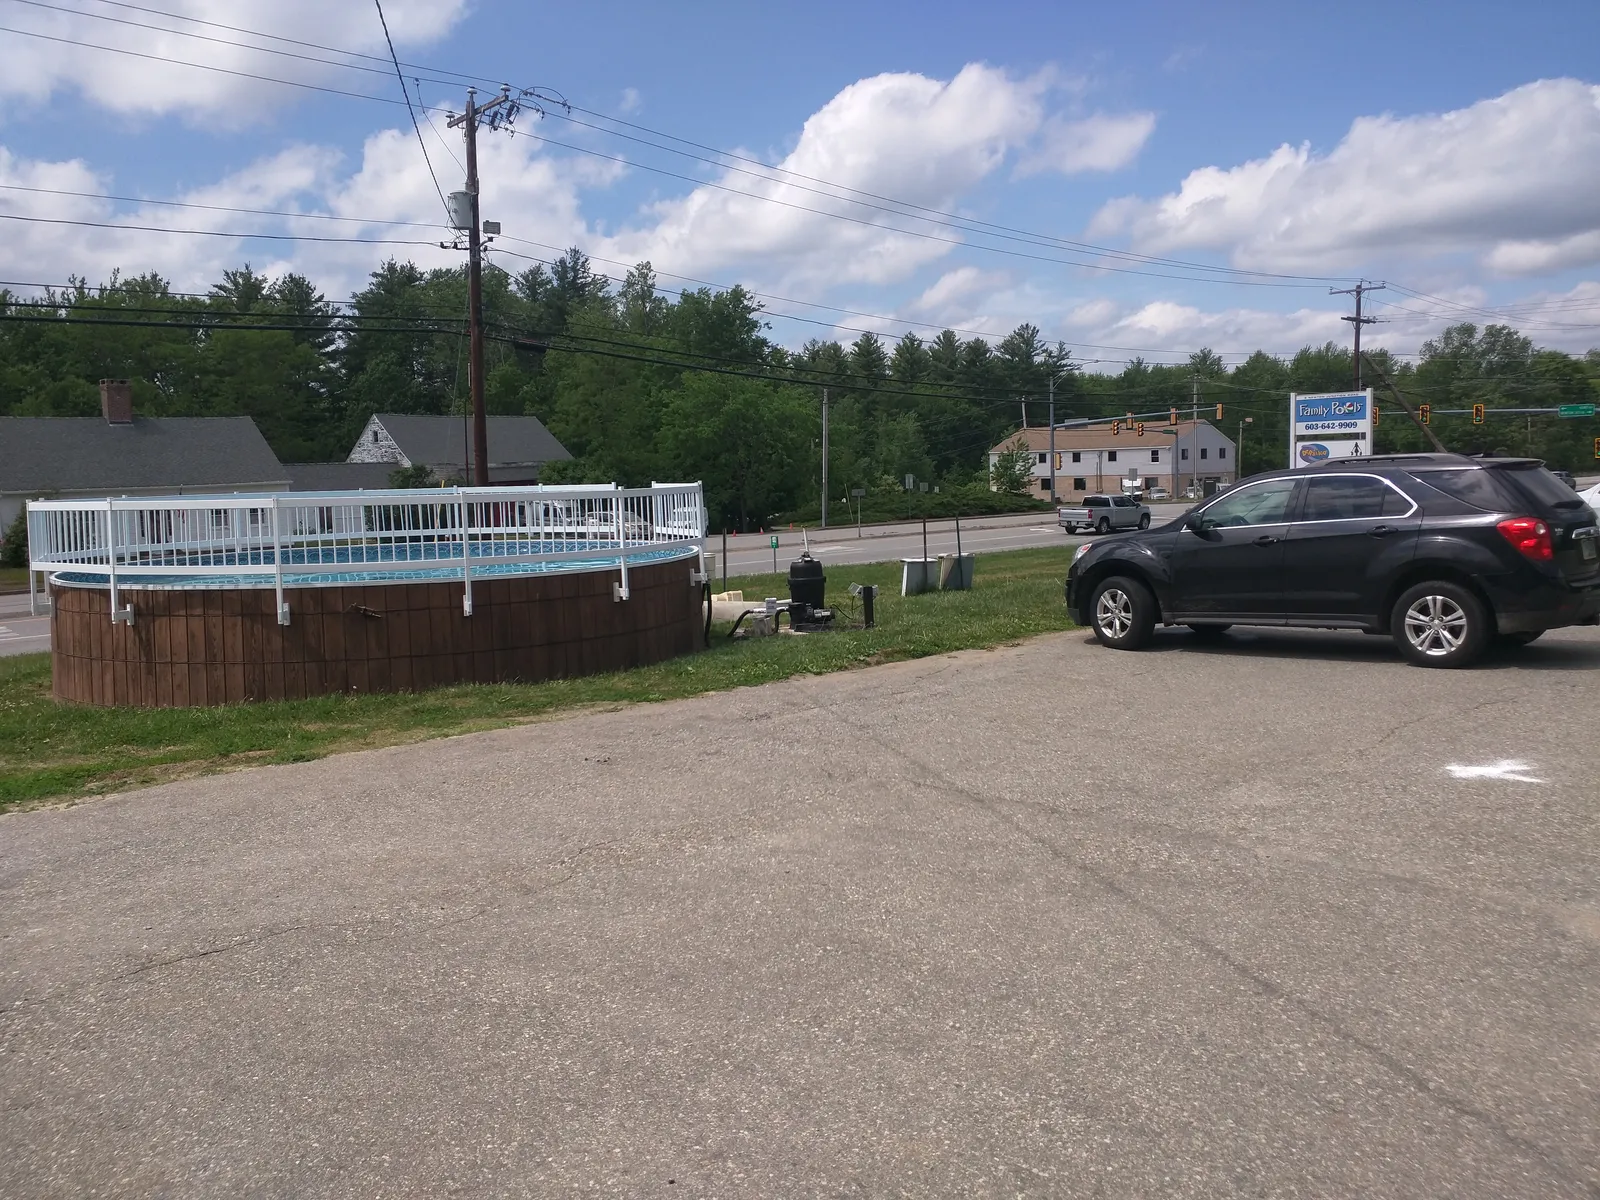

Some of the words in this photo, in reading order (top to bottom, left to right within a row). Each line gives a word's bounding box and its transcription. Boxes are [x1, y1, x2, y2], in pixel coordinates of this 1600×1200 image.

[1299, 404, 1330, 417] Family
[1331, 401, 1362, 414] Pools
[1304, 421, 1358, 430] 603-642-9909
